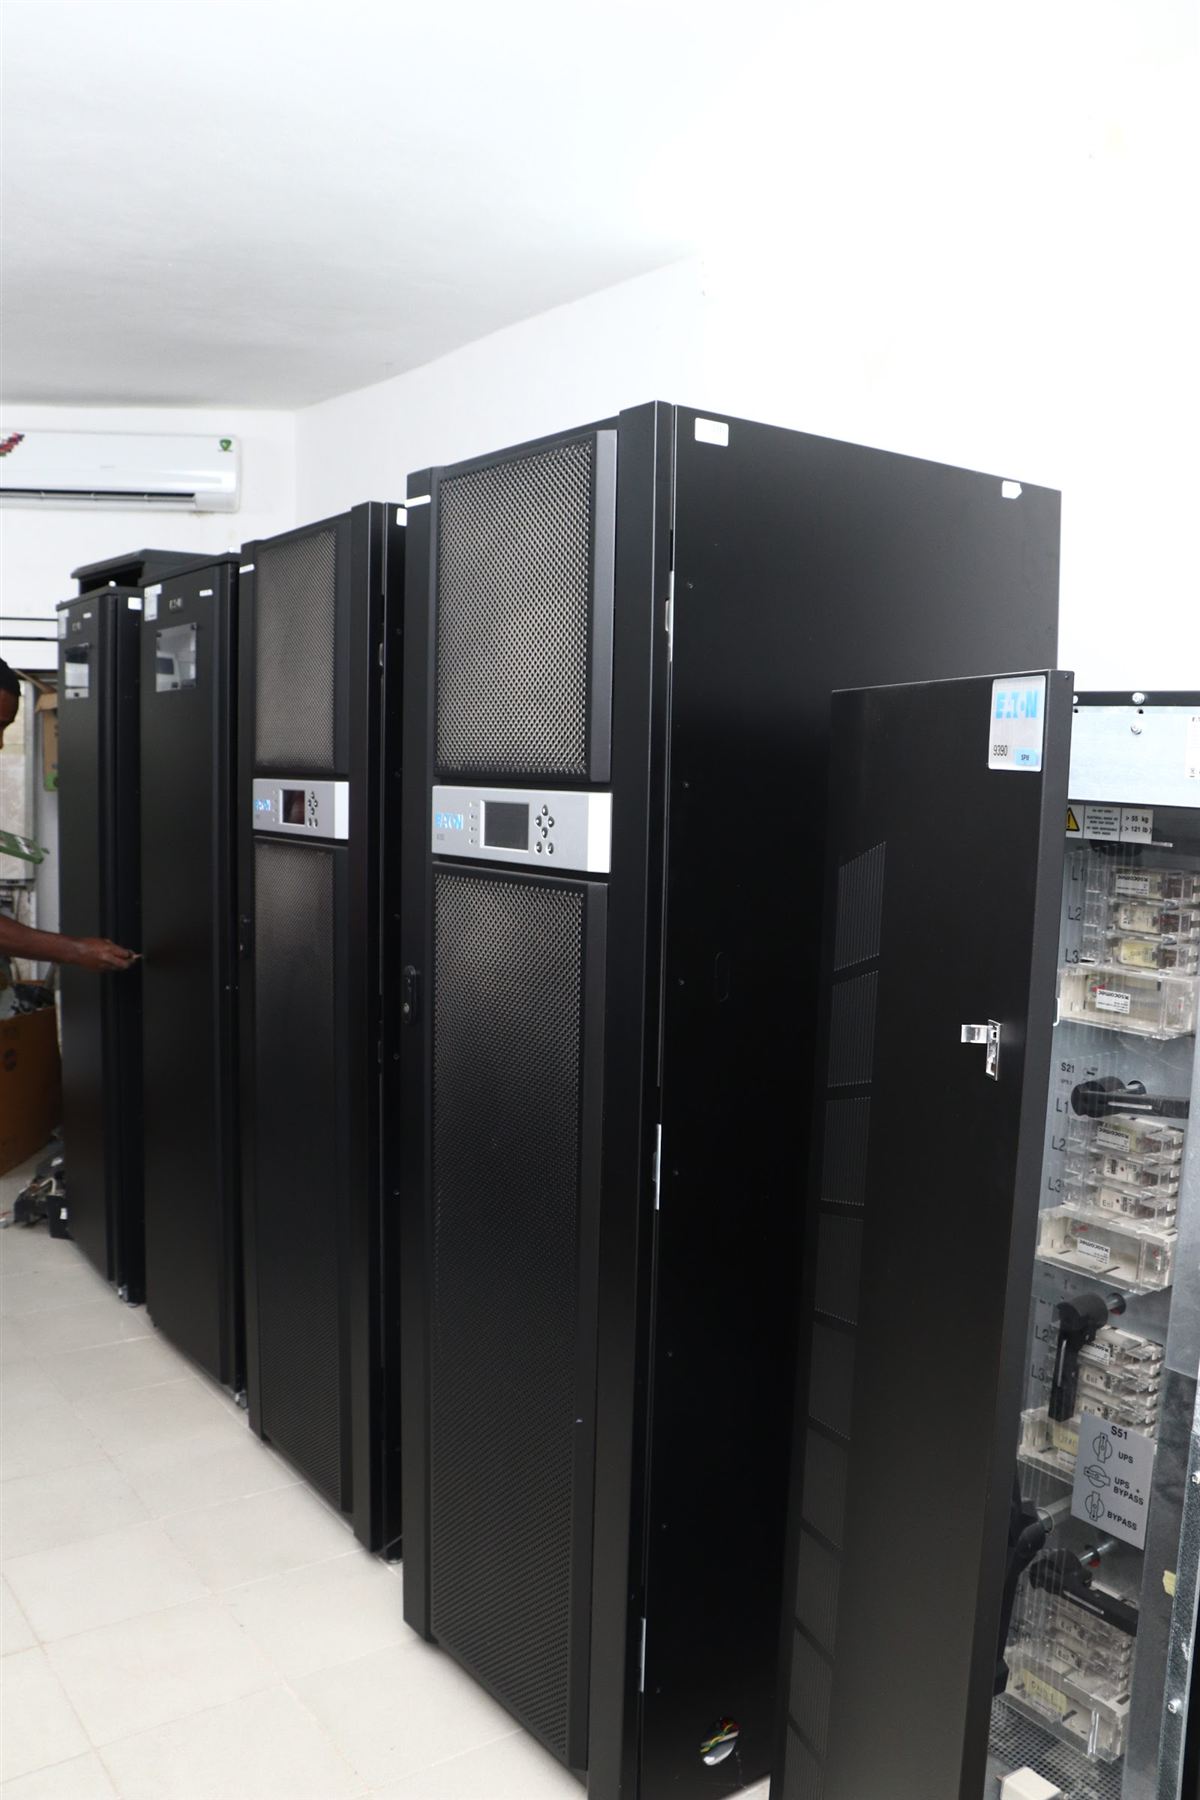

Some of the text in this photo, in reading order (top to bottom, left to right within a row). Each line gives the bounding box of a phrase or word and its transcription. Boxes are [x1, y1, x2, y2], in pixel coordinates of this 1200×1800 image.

[993, 744, 1008, 757] 9390
[1141, 815, 1149, 824] kg
[1071, 866, 1084, 881] L1
[1068, 906, 1081, 921] L2
[1065, 948, 1079, 964] L3
[1060, 1062, 1075, 1073] S21
[1056, 1098, 1069, 1114] L1
[1052, 1135, 1066, 1152] L2
[1048, 1177, 1061, 1193] L3
[1035, 1325, 1049, 1342] L2
[1031, 1364, 1045, 1381] L3
[1111, 1425, 1128, 1440] S51
[1118, 1452, 1133, 1464] UPS
[1114, 1477, 1130, 1489] UPS
[1113, 1486, 1144, 1506] BYPASS
[1107, 1511, 1137, 1531] BYPASS
